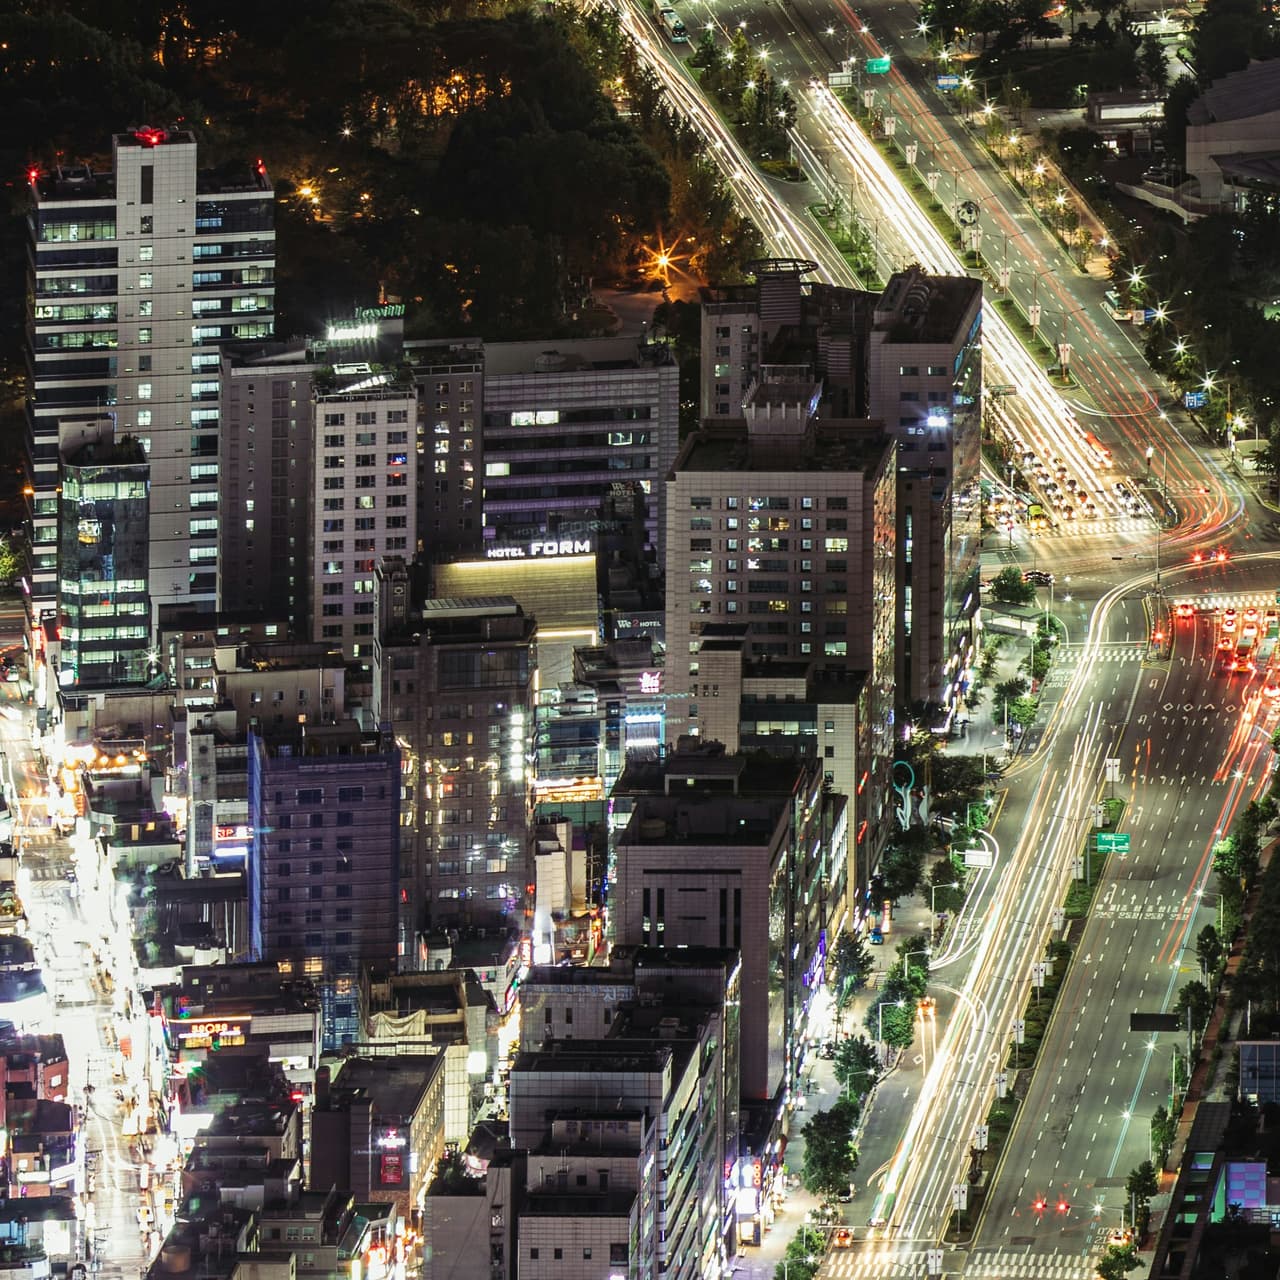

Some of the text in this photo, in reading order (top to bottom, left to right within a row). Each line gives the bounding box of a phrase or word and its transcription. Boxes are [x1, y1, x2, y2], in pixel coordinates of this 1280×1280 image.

[487, 540, 590, 558] HOTEL FORM
[617, 619, 662, 628] We 2 HOTEL
